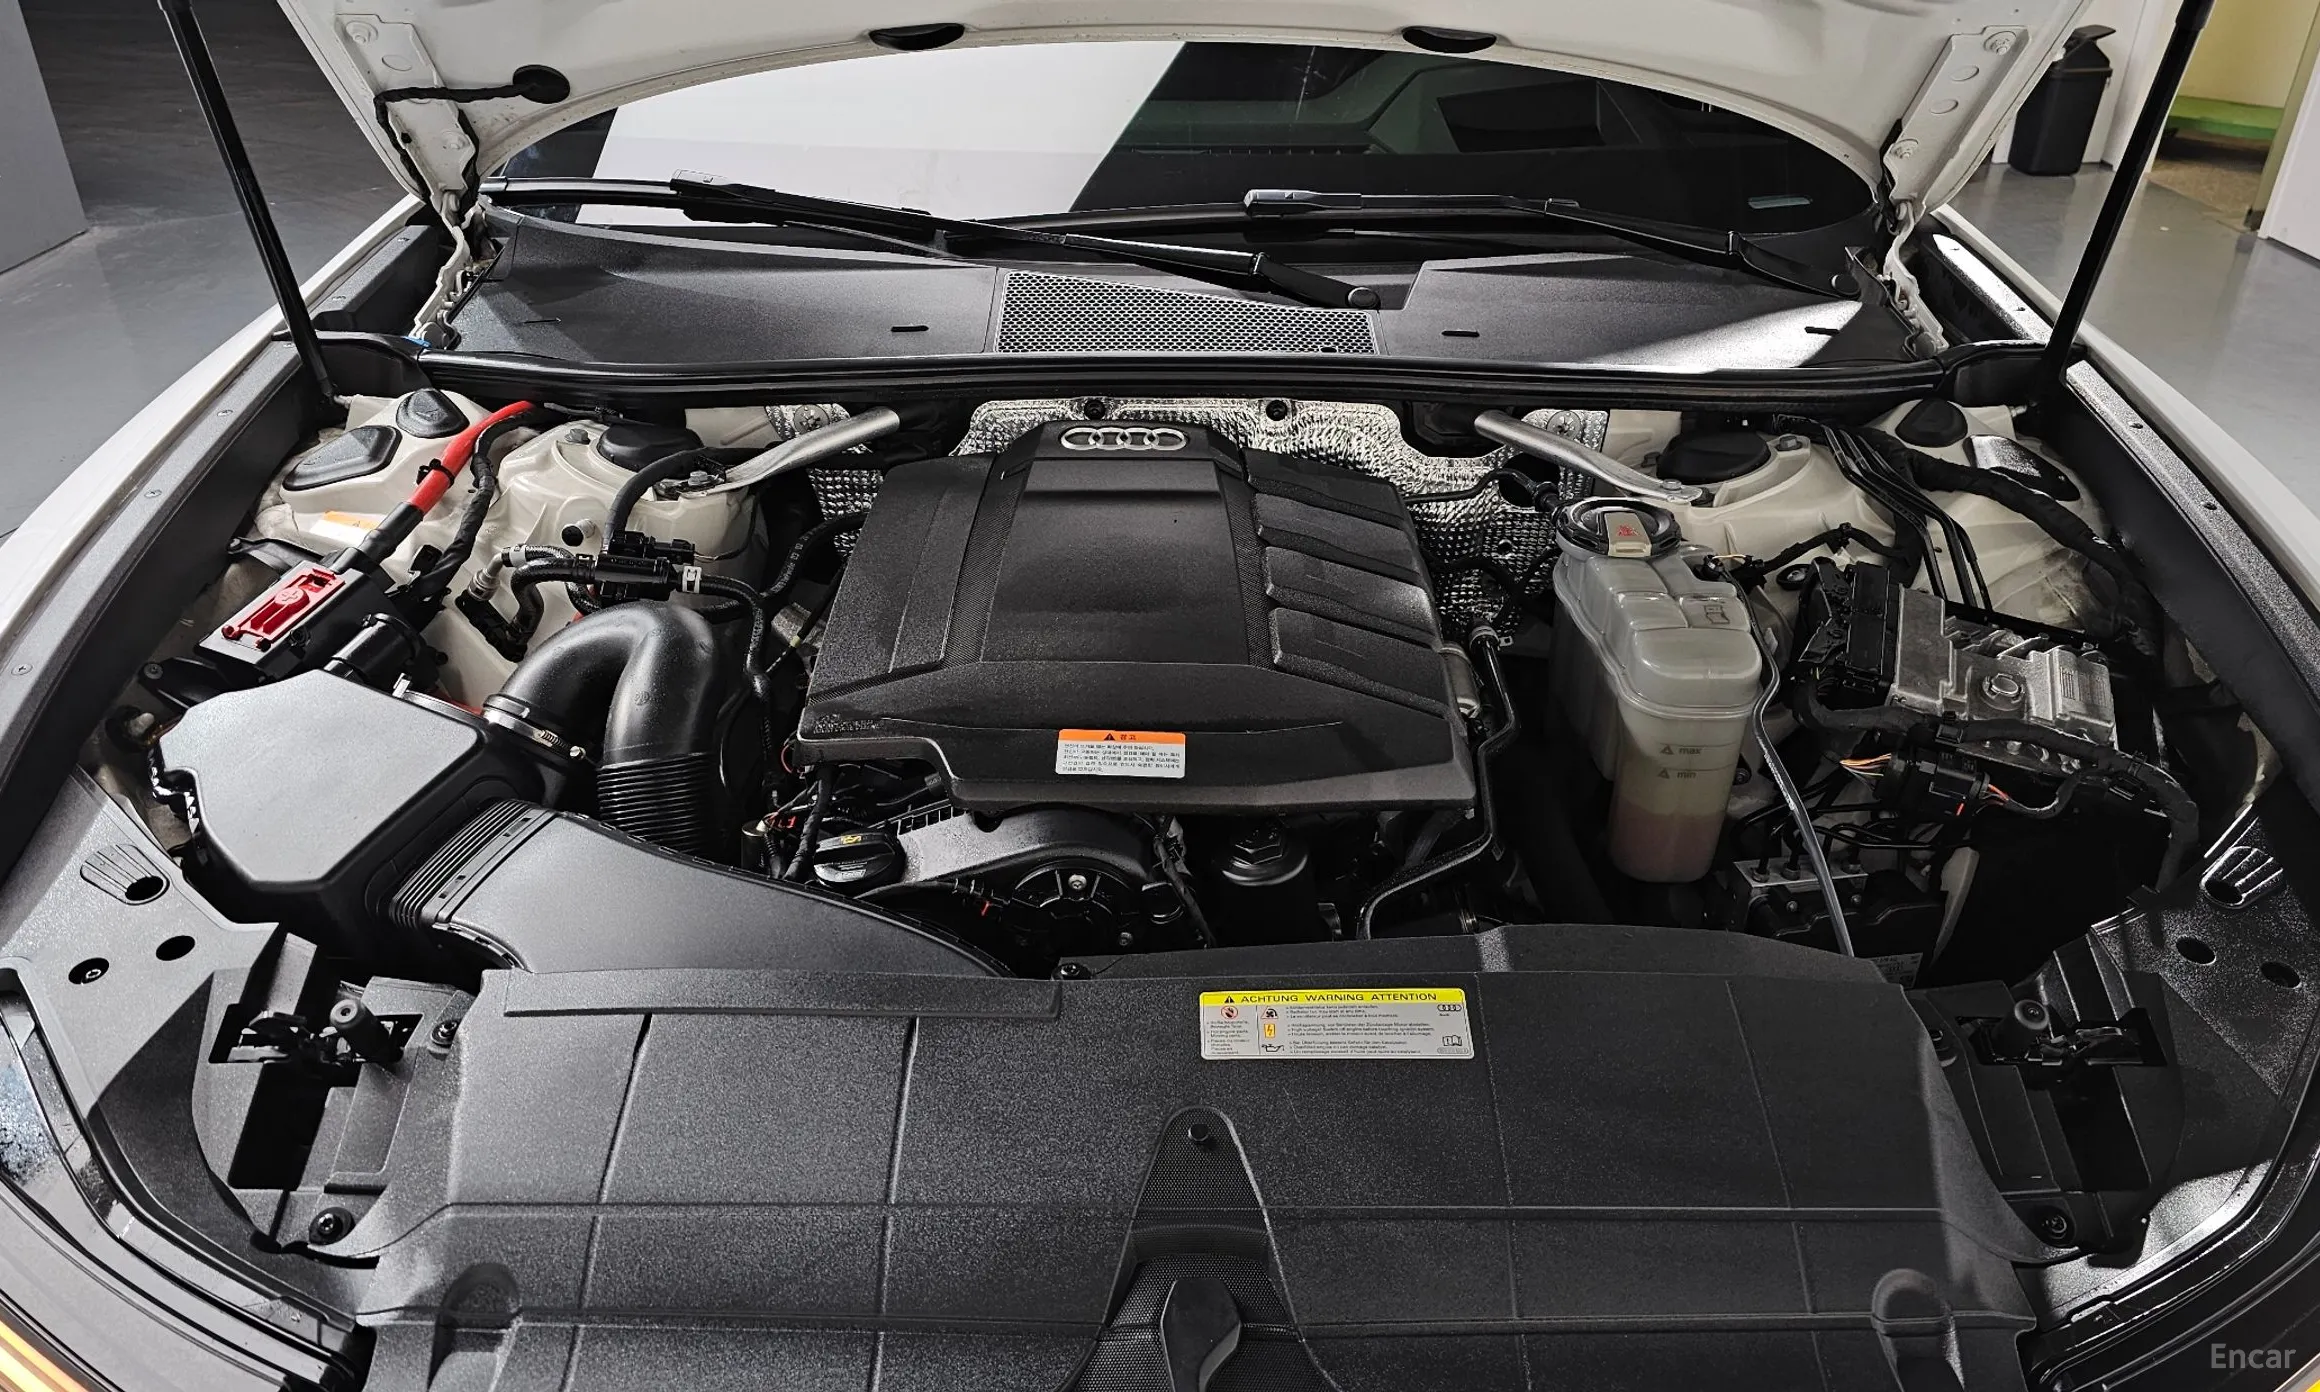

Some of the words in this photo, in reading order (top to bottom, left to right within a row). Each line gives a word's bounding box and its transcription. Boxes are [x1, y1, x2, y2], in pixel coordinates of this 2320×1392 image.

[1678, 747, 1702, 755] max
[1241, 994, 1298, 1003] ACHTUNG
[1304, 993, 1364, 1001] WARNING
[1371, 992, 1437, 1001] ATTENTION
